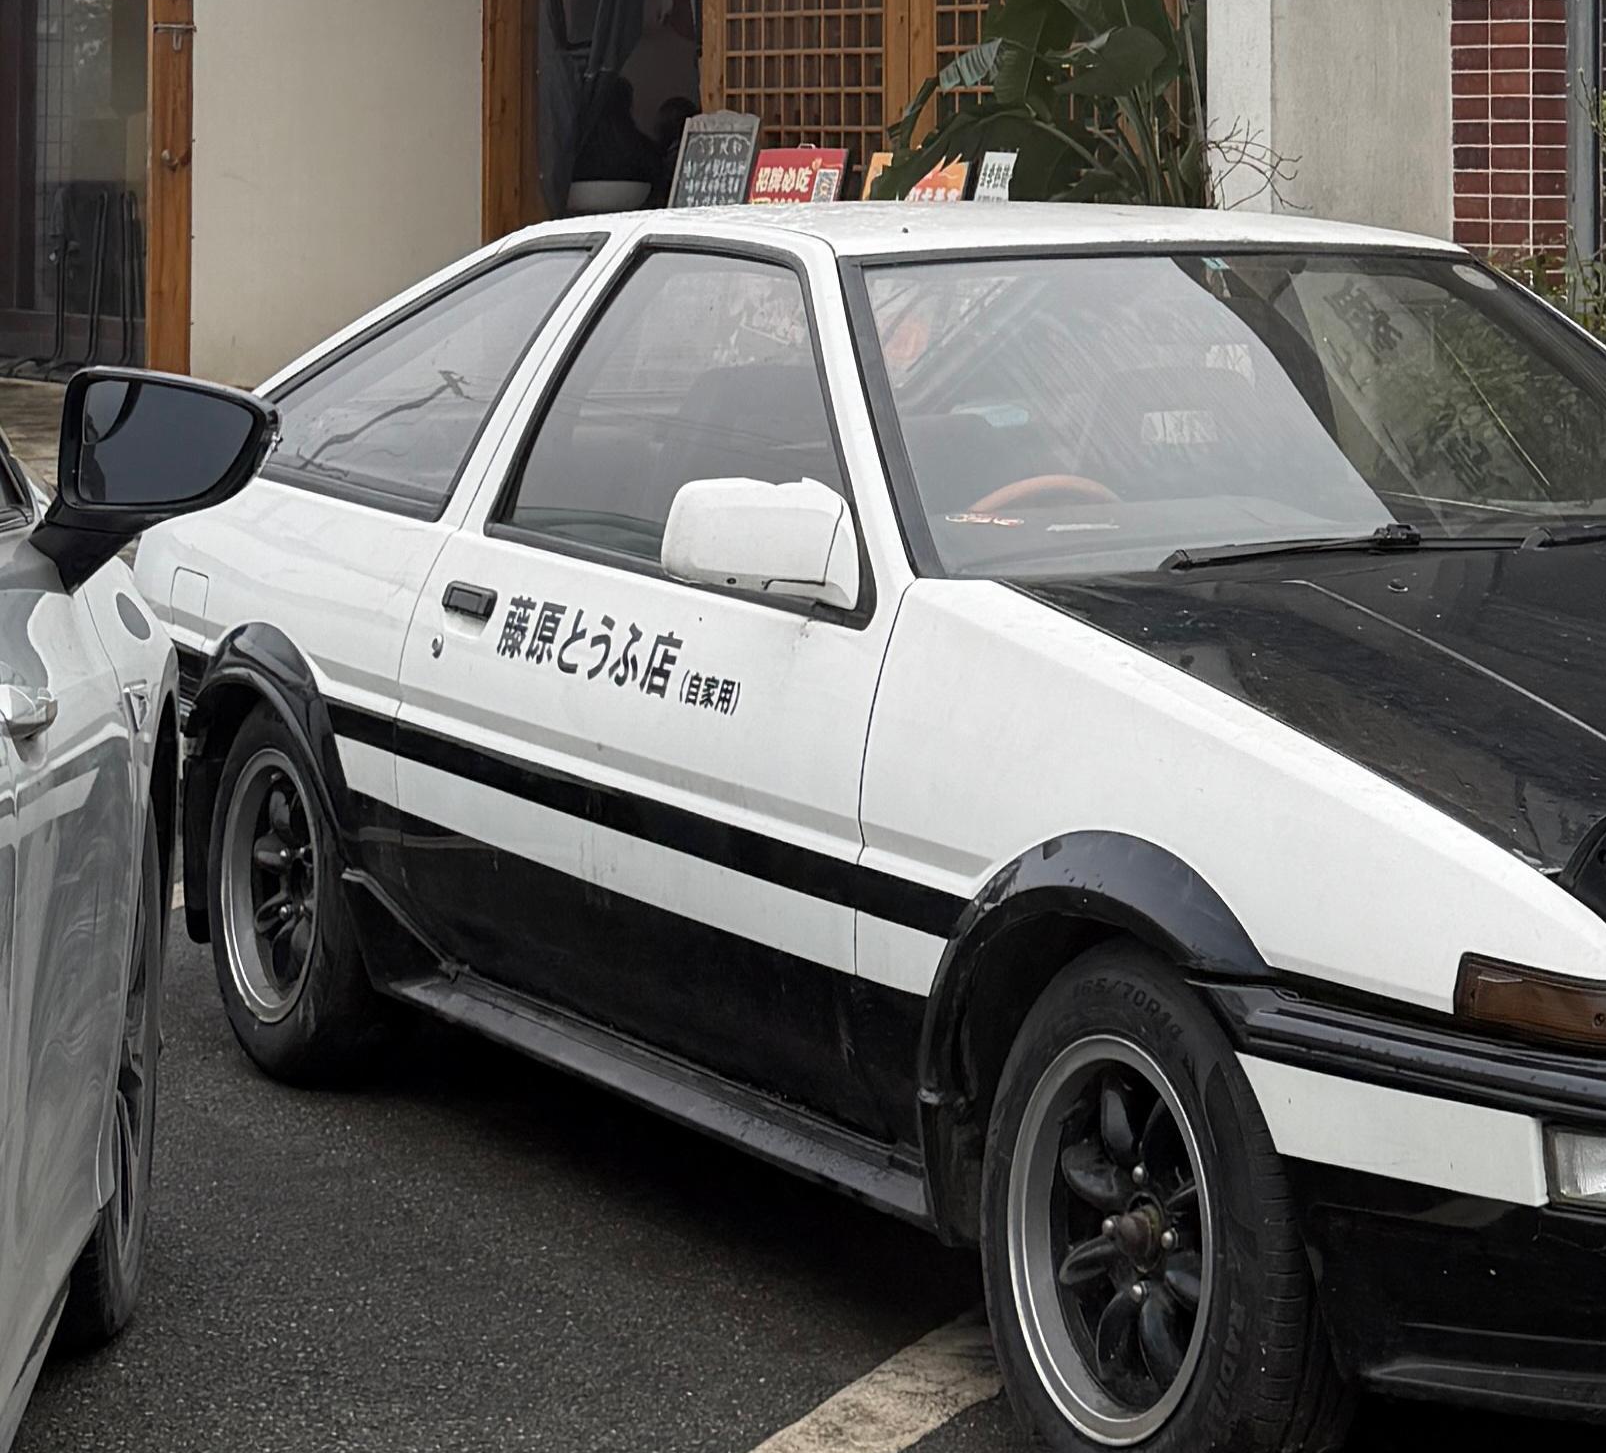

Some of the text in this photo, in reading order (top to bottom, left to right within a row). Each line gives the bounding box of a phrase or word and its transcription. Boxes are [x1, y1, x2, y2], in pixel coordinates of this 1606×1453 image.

[755, 165, 813, 193] 招牌必吃
[496, 594, 684, 699] 藤原とうふ店
